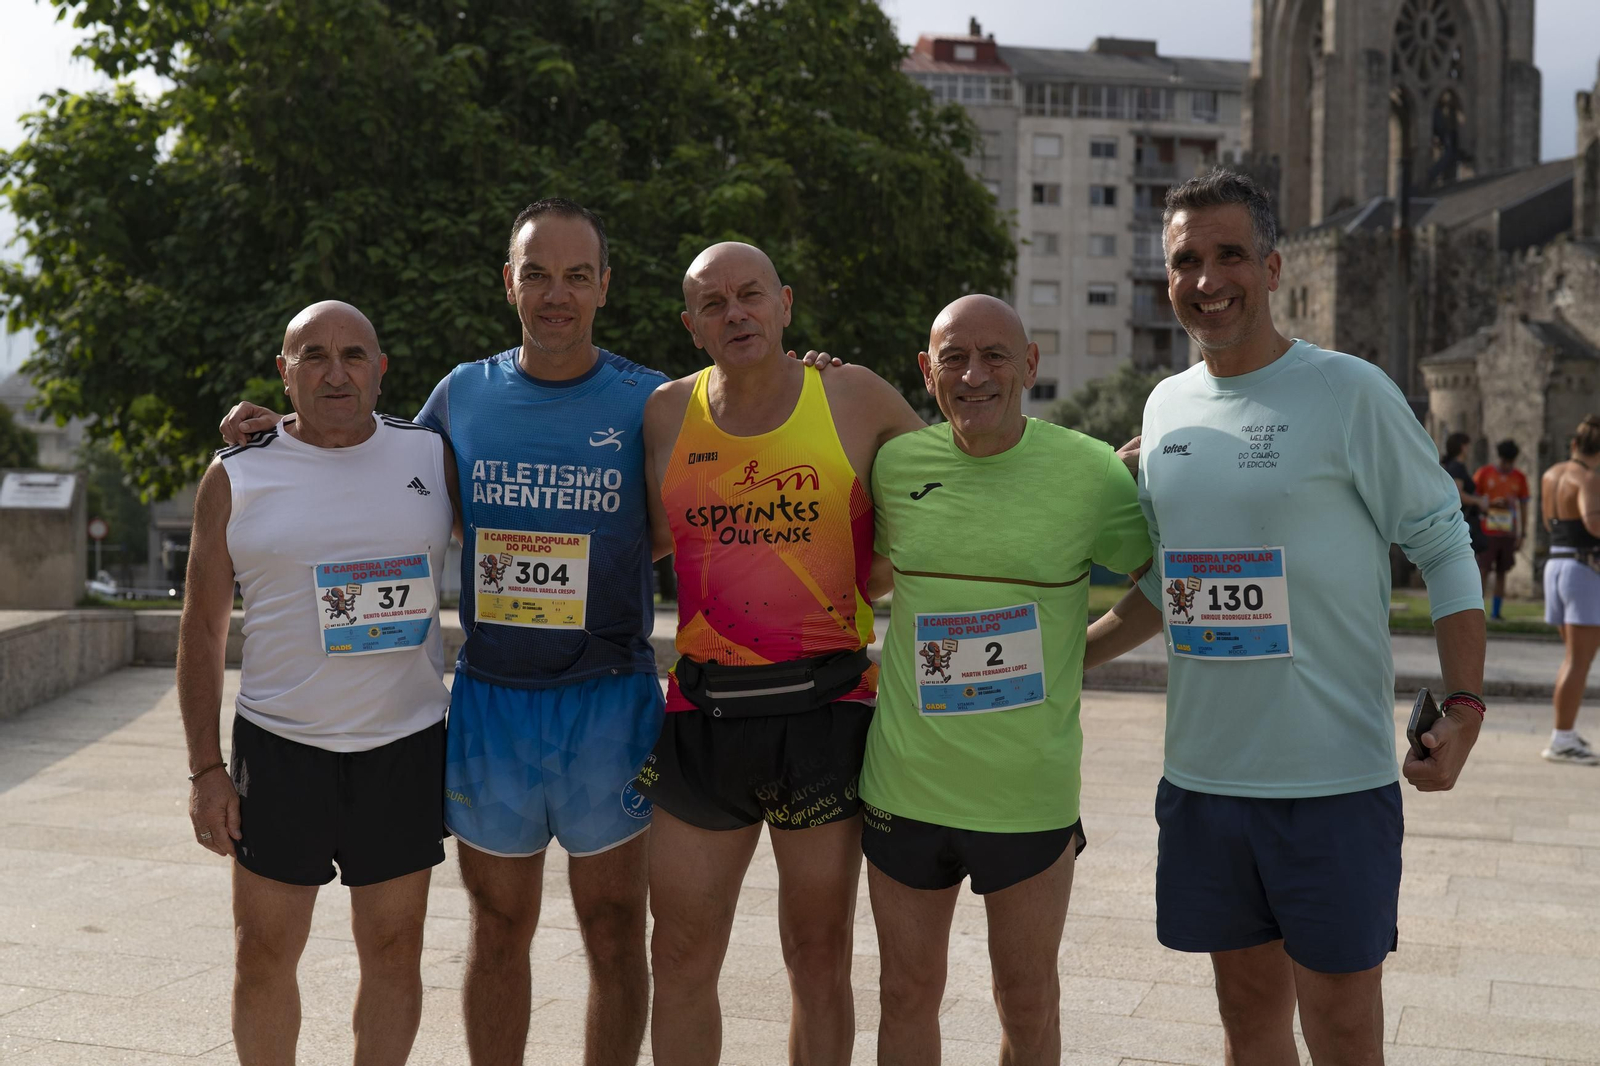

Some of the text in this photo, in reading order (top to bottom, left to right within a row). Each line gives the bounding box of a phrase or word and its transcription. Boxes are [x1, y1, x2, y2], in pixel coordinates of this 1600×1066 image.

[696, 452, 718, 463] INVERSE
[1251, 451, 1280, 459] CAMIÑO
[472, 459, 622, 490] ATLETISMO
[472, 482, 621, 513] ARENTEIRO
[490, 533, 532, 543] CARREIRA
[535, 536, 580, 546] POPULAR
[522, 545, 552, 553] PULPO
[1176, 554, 1220, 563] CARREIRA
[1222, 552, 1273, 562] POPULAR
[332, 562, 382, 573] CARREIRA
[384, 557, 422, 569] POPULAR
[1193, 564, 1241, 573] DO PULPO
[352, 569, 402, 580] DO PULPO
[515, 562, 569, 586] 304
[378, 585, 410, 609] 37
[1208, 584, 1263, 611] 130
[363, 611, 380, 619] BENITO
[930, 616, 978, 626] CARREIRA
[981, 608, 1028, 623] POPULAR
[948, 623, 1000, 635] DO PULPO
[985, 642, 1004, 666] 2
[982, 667, 1011, 676] FERNANDEZ
